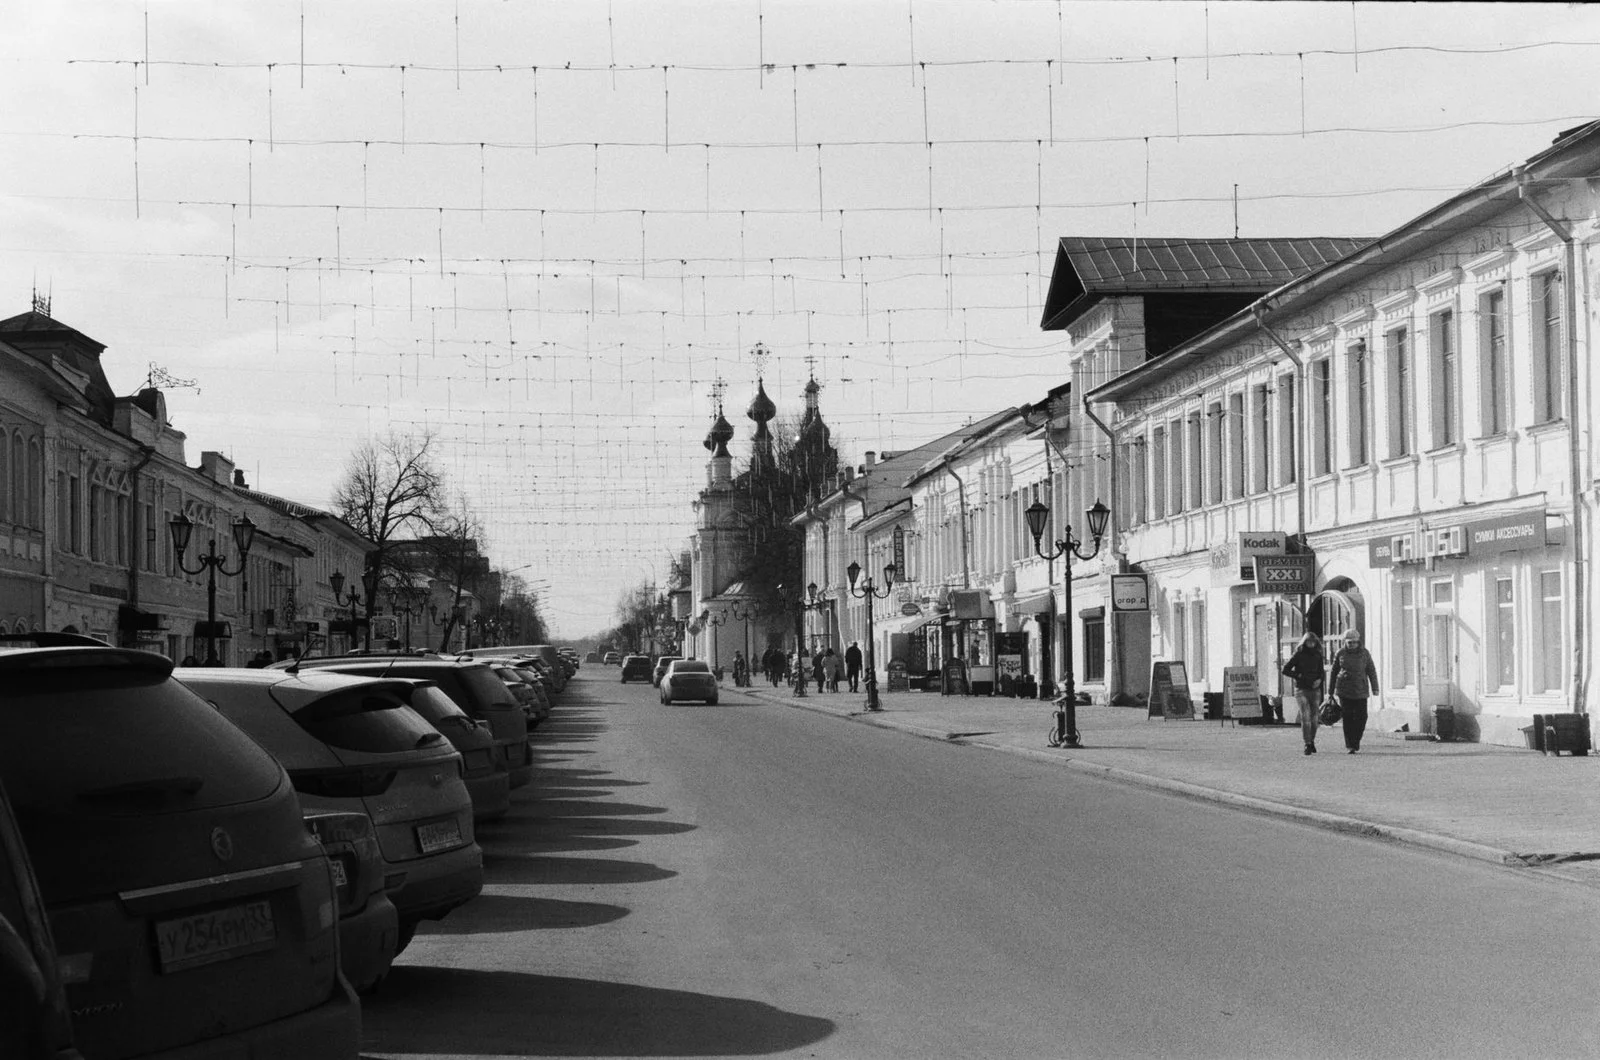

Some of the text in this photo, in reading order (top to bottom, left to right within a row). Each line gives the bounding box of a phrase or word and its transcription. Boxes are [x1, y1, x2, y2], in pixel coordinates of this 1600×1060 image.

[1475, 523, 1535, 543] СУМКИ АКСЕССУАРЫ
[1243, 538, 1281, 549] Kodak
[1267, 569, 1302, 580] XXI
[1229, 673, 1255, 682] ОБУВЬ
